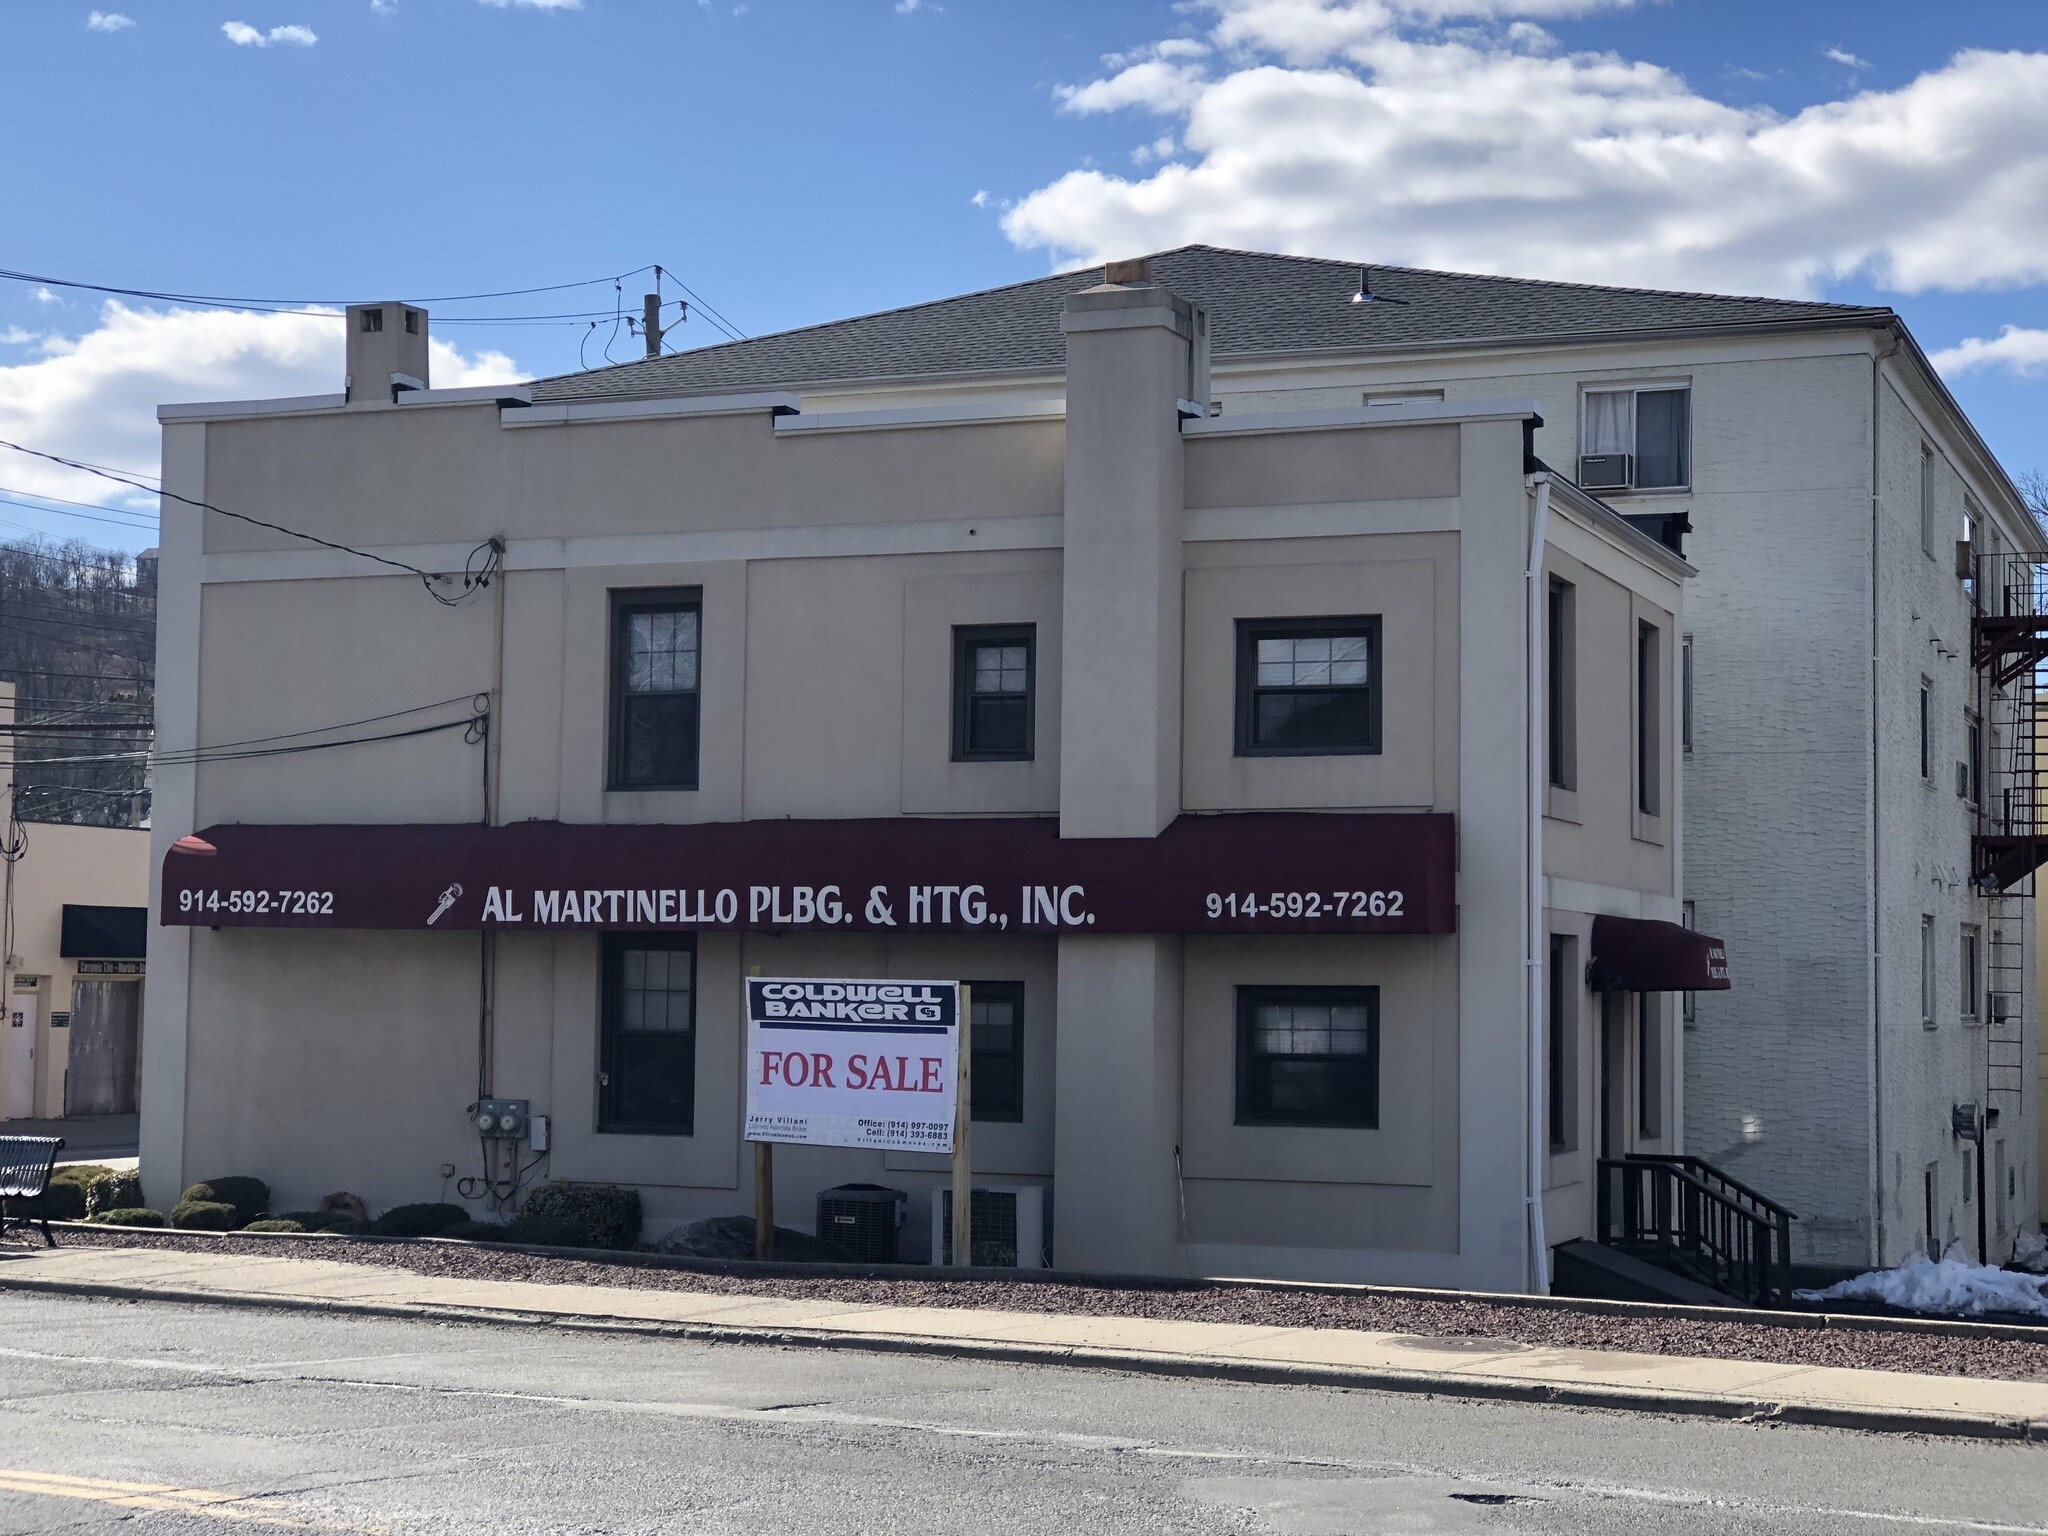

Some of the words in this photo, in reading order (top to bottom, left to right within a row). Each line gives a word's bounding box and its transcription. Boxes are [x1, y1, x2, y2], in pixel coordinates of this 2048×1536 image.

[178, 889, 335, 915] 914-592-7262
[481, 886, 523, 923] AL
[533, 888, 740, 924] MARTINELLO
[750, 885, 853, 926] PLBG.
[864, 885, 895, 926] &
[908, 884, 1008, 930] HTG.,
[1021, 884, 1096, 926] INC.
[1205, 890, 1405, 919] 914-592-7262
[759, 1051, 836, 1088] FOR
[846, 1054, 944, 1093] SALE
[749, 1115, 773, 1124] Jerry
[777, 1117, 808, 1125] Villani
[857, 1119, 886, 1128] Office:
[887, 1120, 909, 1130] (914)
[911, 1122, 949, 1131] 997-0097
[866, 1128, 885, 1137] Cell:
[887, 1129, 908, 1139] (914)
